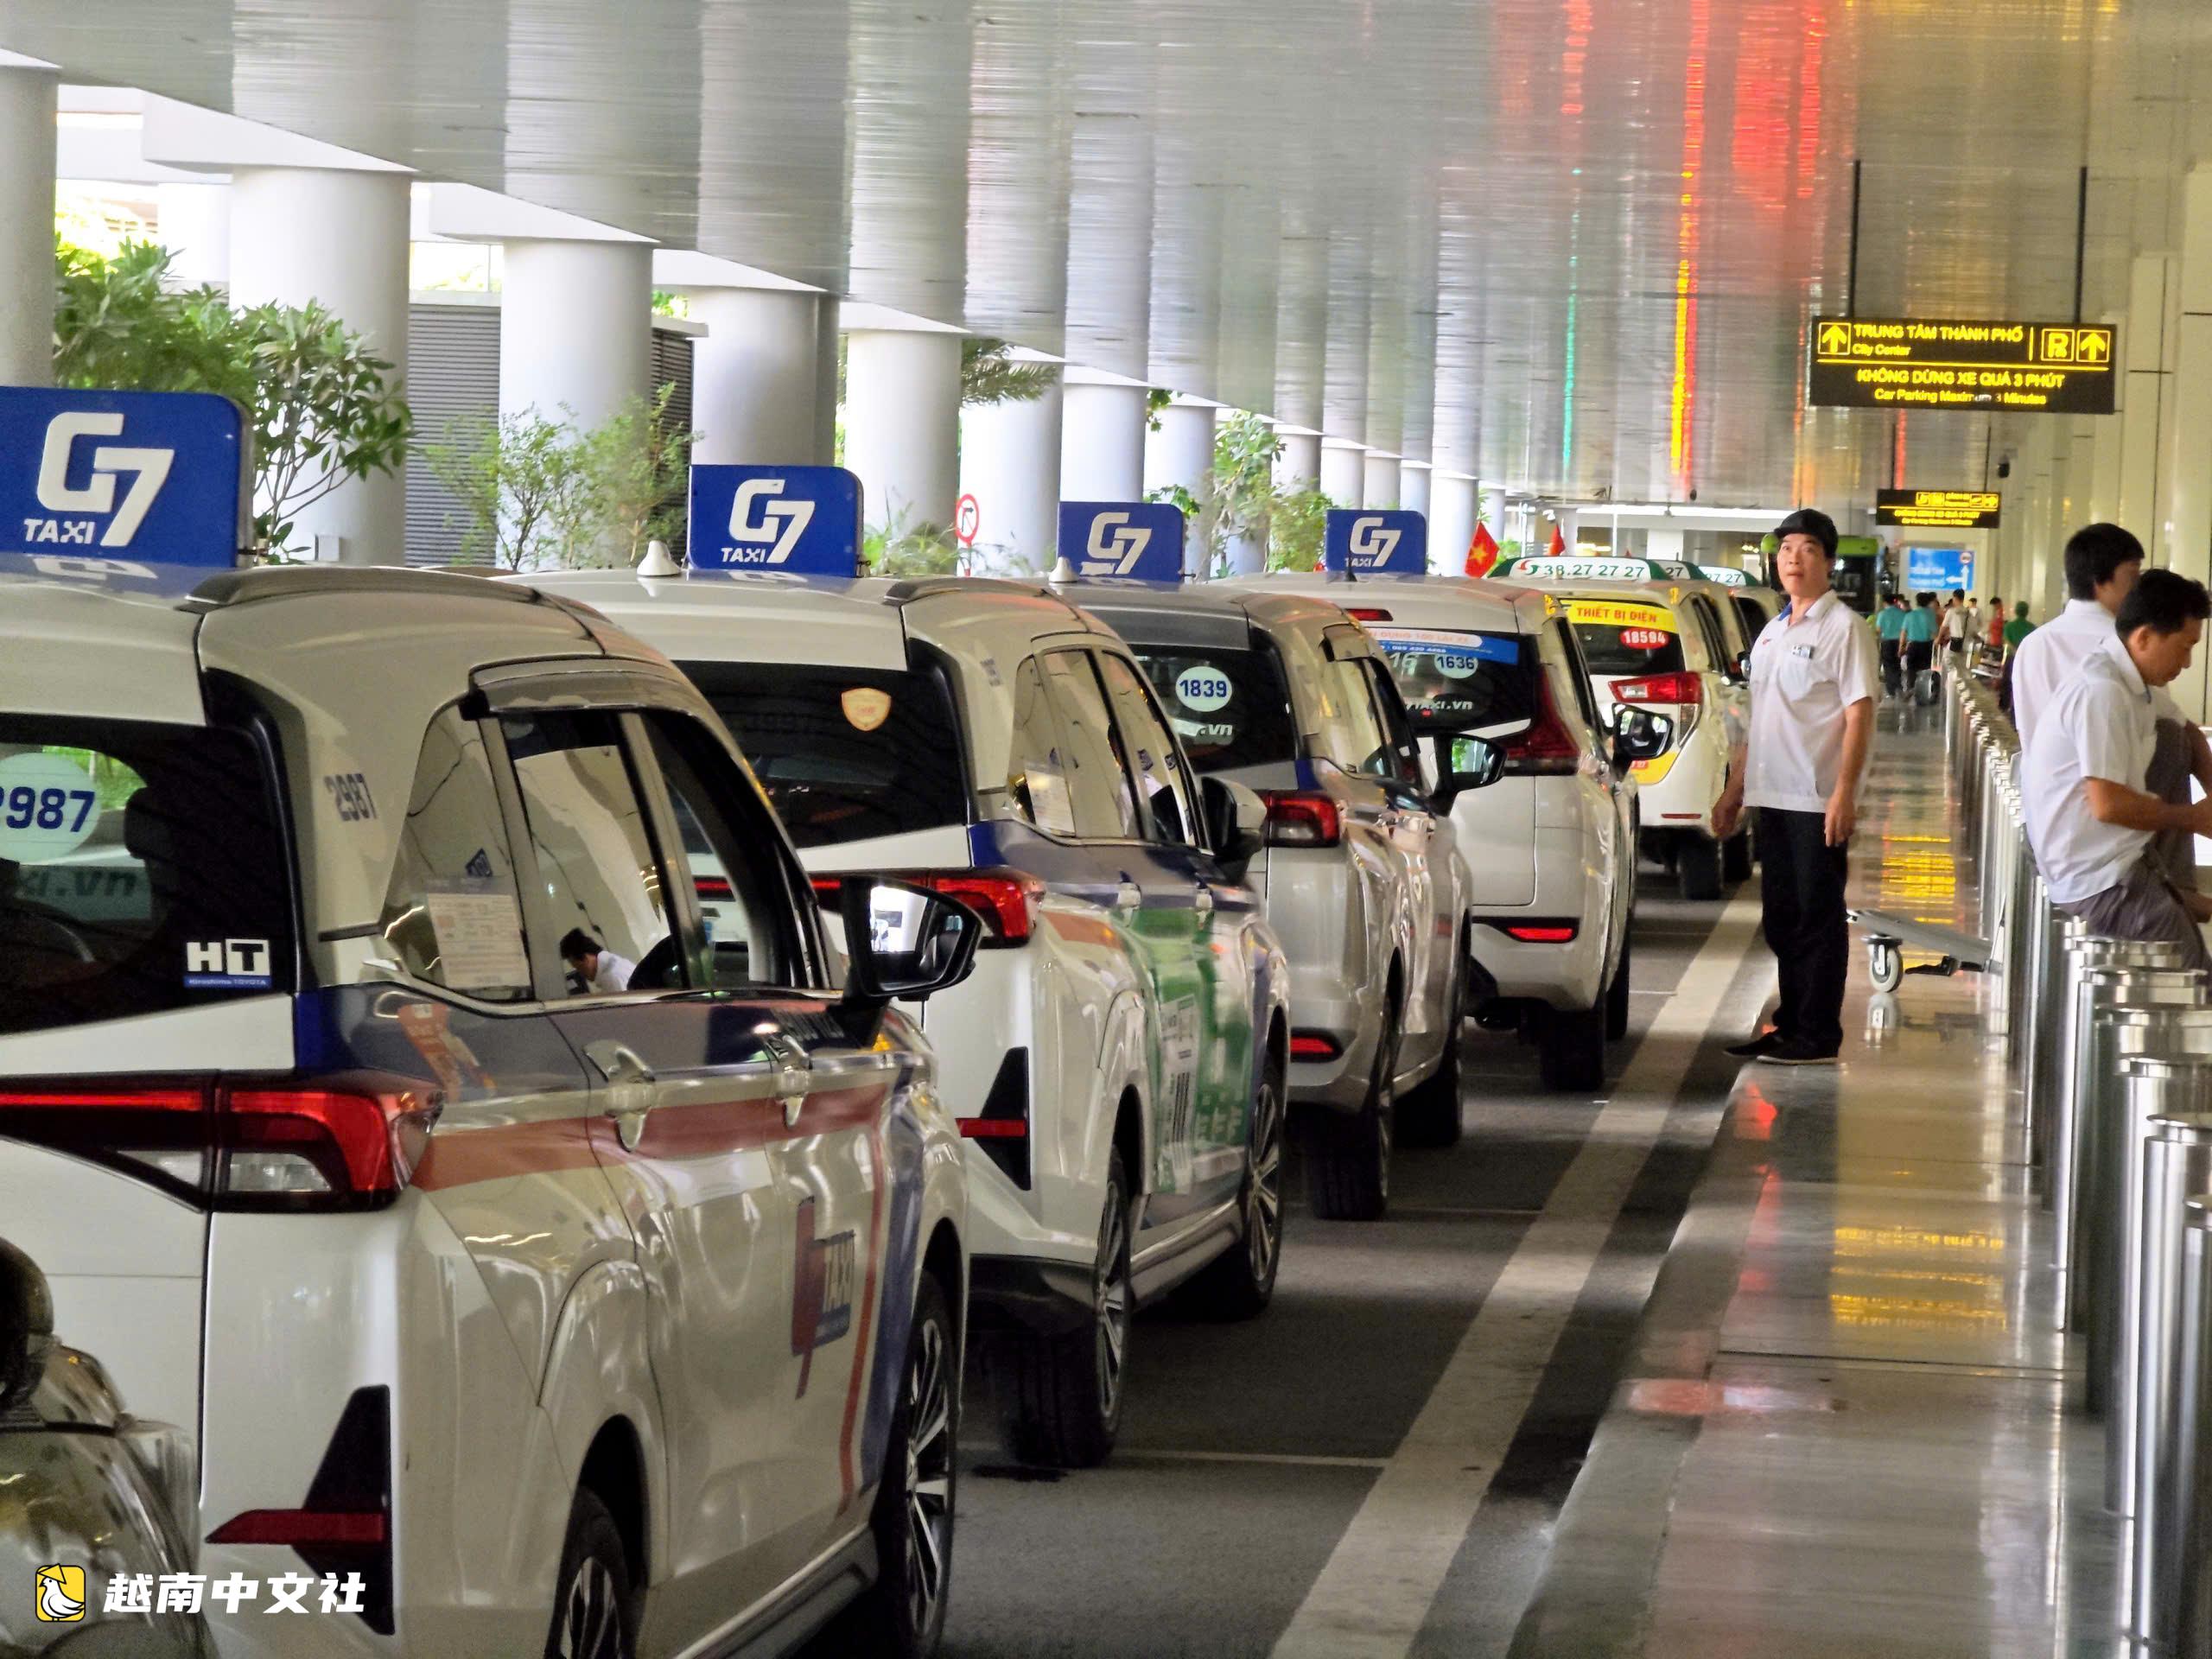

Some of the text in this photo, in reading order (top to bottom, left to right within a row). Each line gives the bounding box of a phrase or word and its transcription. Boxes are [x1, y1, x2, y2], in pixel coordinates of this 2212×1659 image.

[1853, 324, 1904, 339] TRUNG
[1907, 324, 1937, 340] TÂM
[1940, 325, 1989, 341] THÀNH
[1853, 343, 1911, 356] City Center
[1857, 367, 1909, 383] KHÔNG
[1957, 372, 1977, 385] XE
[1980, 371, 2012, 386] QUÁ
[2013, 373, 2023, 387] 3
[2025, 372, 2066, 388] PHÚT
[1874, 388, 1895, 400] Car
[1897, 389, 1938, 403] Parking
[2004, 392, 2047, 405] Minutes
[36, 411, 175, 547] G7
[24, 518, 96, 544] TAXI
[728, 479, 816, 563] G7
[1087, 512, 1153, 575] G7
[1350, 517, 1402, 567] G7
[721, 547, 766, 563] TAXI
[1599, 564, 1619, 576] 27
[1624, 566, 1645, 577] 27
[1624, 631, 1667, 644] 18594
[1437, 655, 1476, 670] 1636
[1179, 679, 1227, 698] 1839
[0, 786, 95, 832] 987
[187, 939, 270, 976] HT
